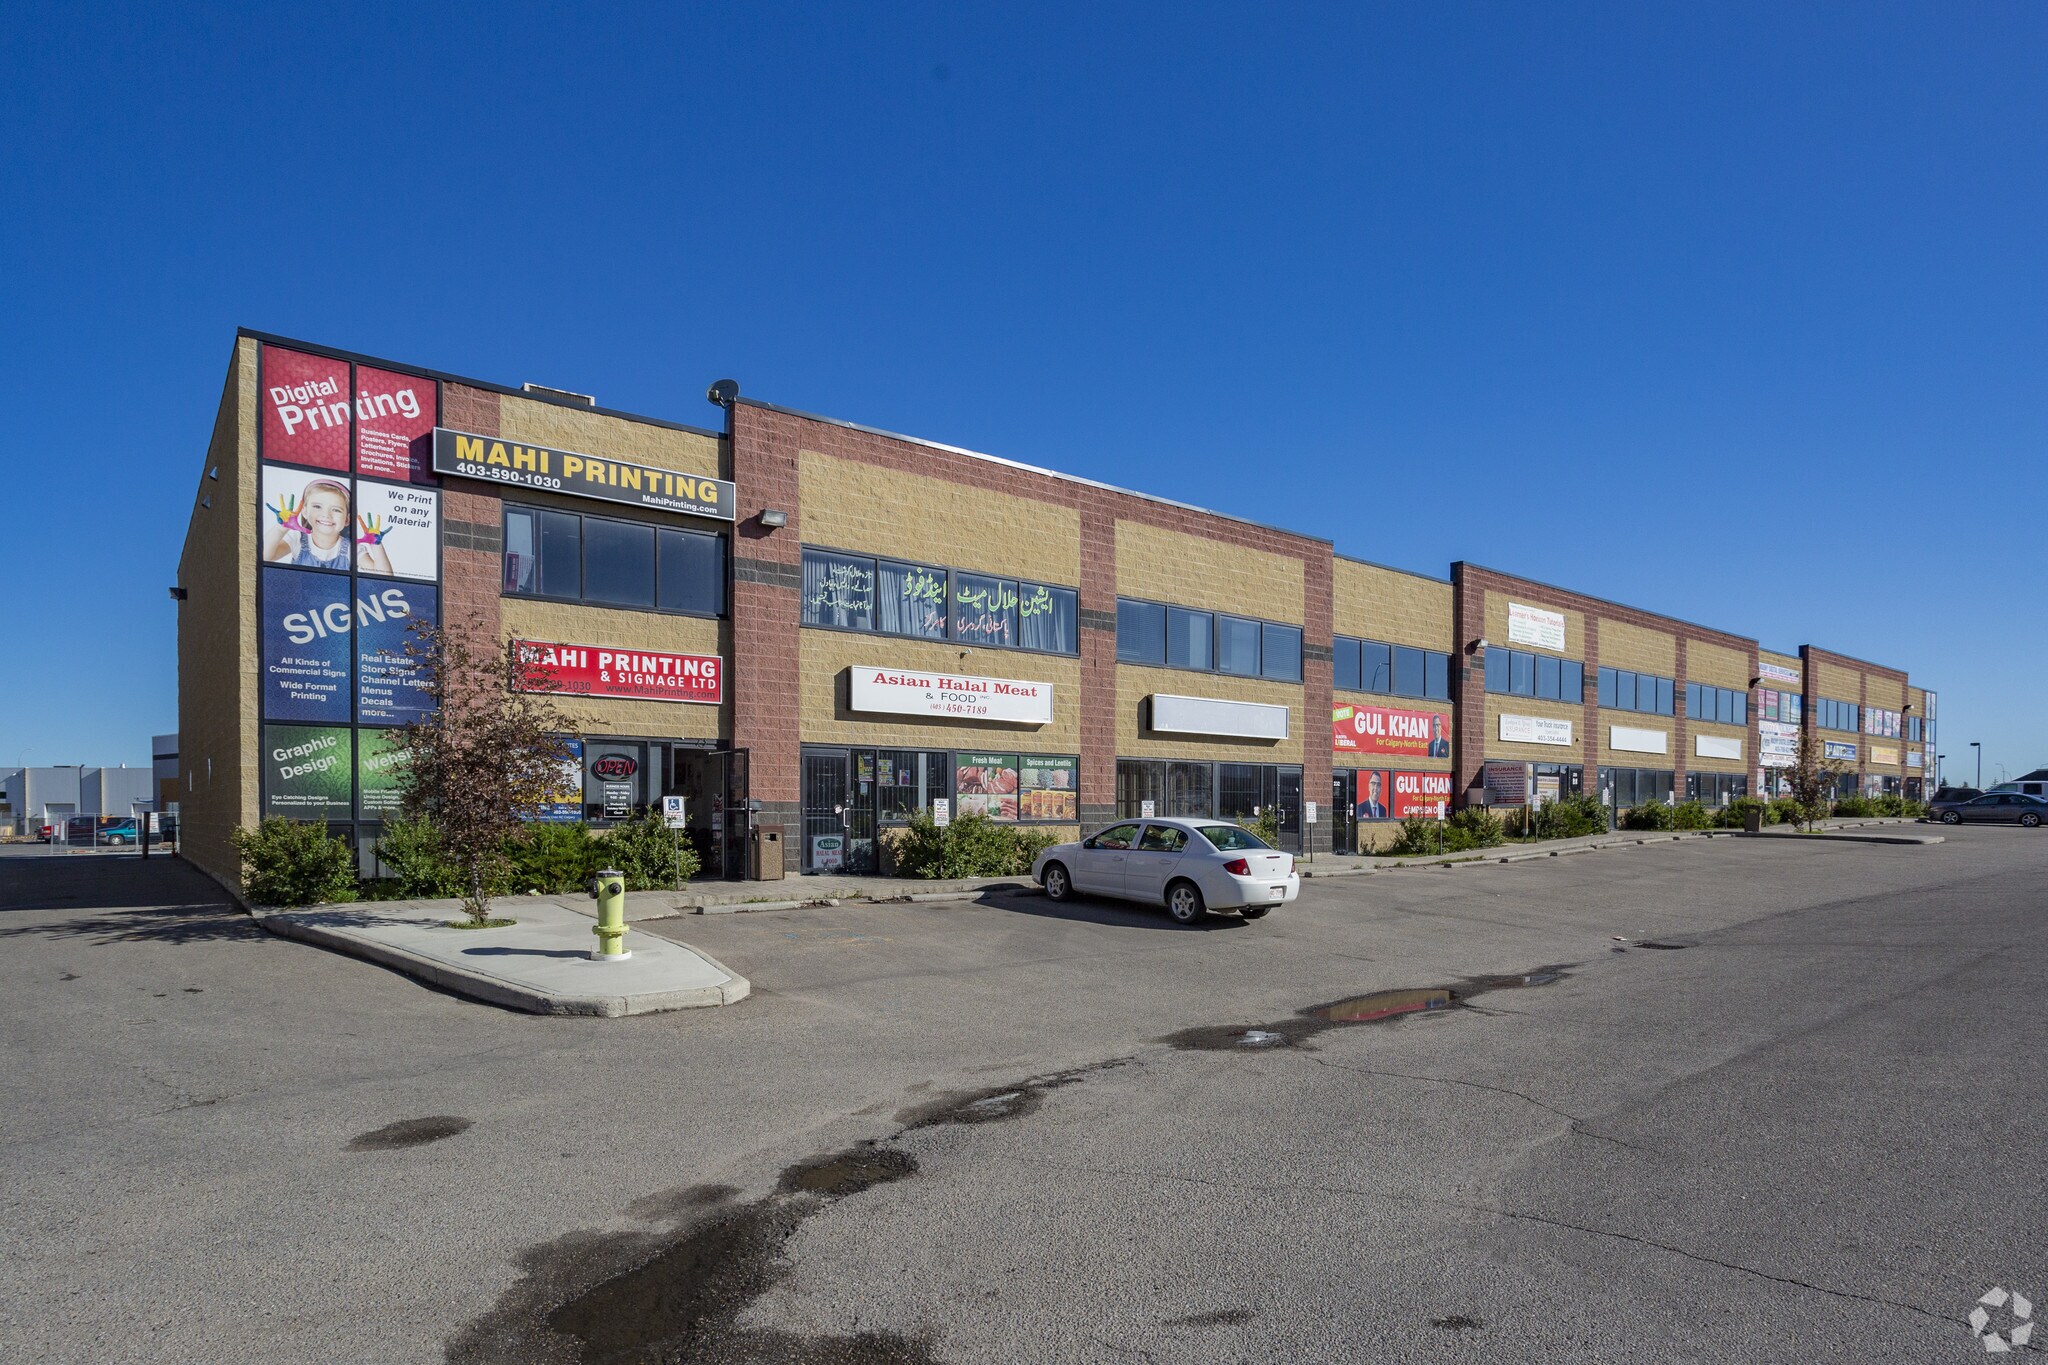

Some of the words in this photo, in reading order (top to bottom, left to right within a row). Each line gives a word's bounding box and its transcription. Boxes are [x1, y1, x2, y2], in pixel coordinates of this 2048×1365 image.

[269, 376, 339, 406] Digital
[277, 388, 420, 436] Printing
[360, 428, 390, 438] Business
[391, 433, 411, 443] Cards,
[360, 435, 387, 445] Posters,
[387, 440, 409, 449] Flyers,
[360, 442, 396, 453] Letterhead,
[360, 449, 395, 460] Brochures,
[360, 456, 395, 467] Invitations,
[456, 435, 549, 474] MAHI
[563, 455, 718, 504] PRINTING
[456, 462, 561, 489] 403-590-1030
[388, 490, 404, 502] We
[406, 494, 433, 505] Print
[642, 494, 718, 514] MahiPrinting.com
[393, 505, 406, 514] on
[410, 507, 430, 518] any
[282, 588, 410, 645] SIGNS
[281, 657, 293, 665] All
[295, 658, 320, 667] Kinds
[361, 653, 383, 664] Real
[385, 656, 415, 666] Estate
[519, 645, 588, 669] MAHI
[598, 652, 716, 677] PRINTING
[269, 665, 321, 677] Commercial
[322, 670, 347, 678] Signs
[361, 664, 386, 674] Store
[389, 666, 416, 677] Signs
[279, 681, 303, 690] Wide
[305, 683, 337, 692] Format
[361, 676, 401, 686] Channel
[402, 678, 435, 688] Letters
[600, 671, 611, 682] &
[618, 673, 685, 688] SIGNAGE
[692, 678, 717, 690] LTD
[872, 672, 931, 688] Asian
[937, 678, 988, 693] Halal
[993, 683, 1039, 697] Meat
[290, 691, 327, 702] Printing
[361, 686, 393, 696] Menus
[605, 684, 716, 699] www.MahiPrinting.com
[925, 692, 934, 700] &
[941, 692, 977, 703] FOOD
[361, 696, 393, 707] Decals
[361, 708, 395, 718] more...
[1354, 711, 1386, 736] GUL
[1388, 715, 1429, 739] KHAN
[272, 735, 337, 762] Graphic
[1335, 738, 1357, 747] LIBERAL
[1376, 738, 1385, 746] For
[279, 754, 338, 780] Design
[972, 756, 988, 765] Fresh
[988, 757, 1003, 765] Meat
[1027, 758, 1044, 768] Spices
[1044, 759, 1055, 767] and
[1055, 759, 1072, 768] Lentils
[594, 758, 636, 777] OPEN
[1396, 775, 1420, 794] GUL
[1422, 776, 1453, 794] KHAN
[820, 840, 839, 849] Asian
